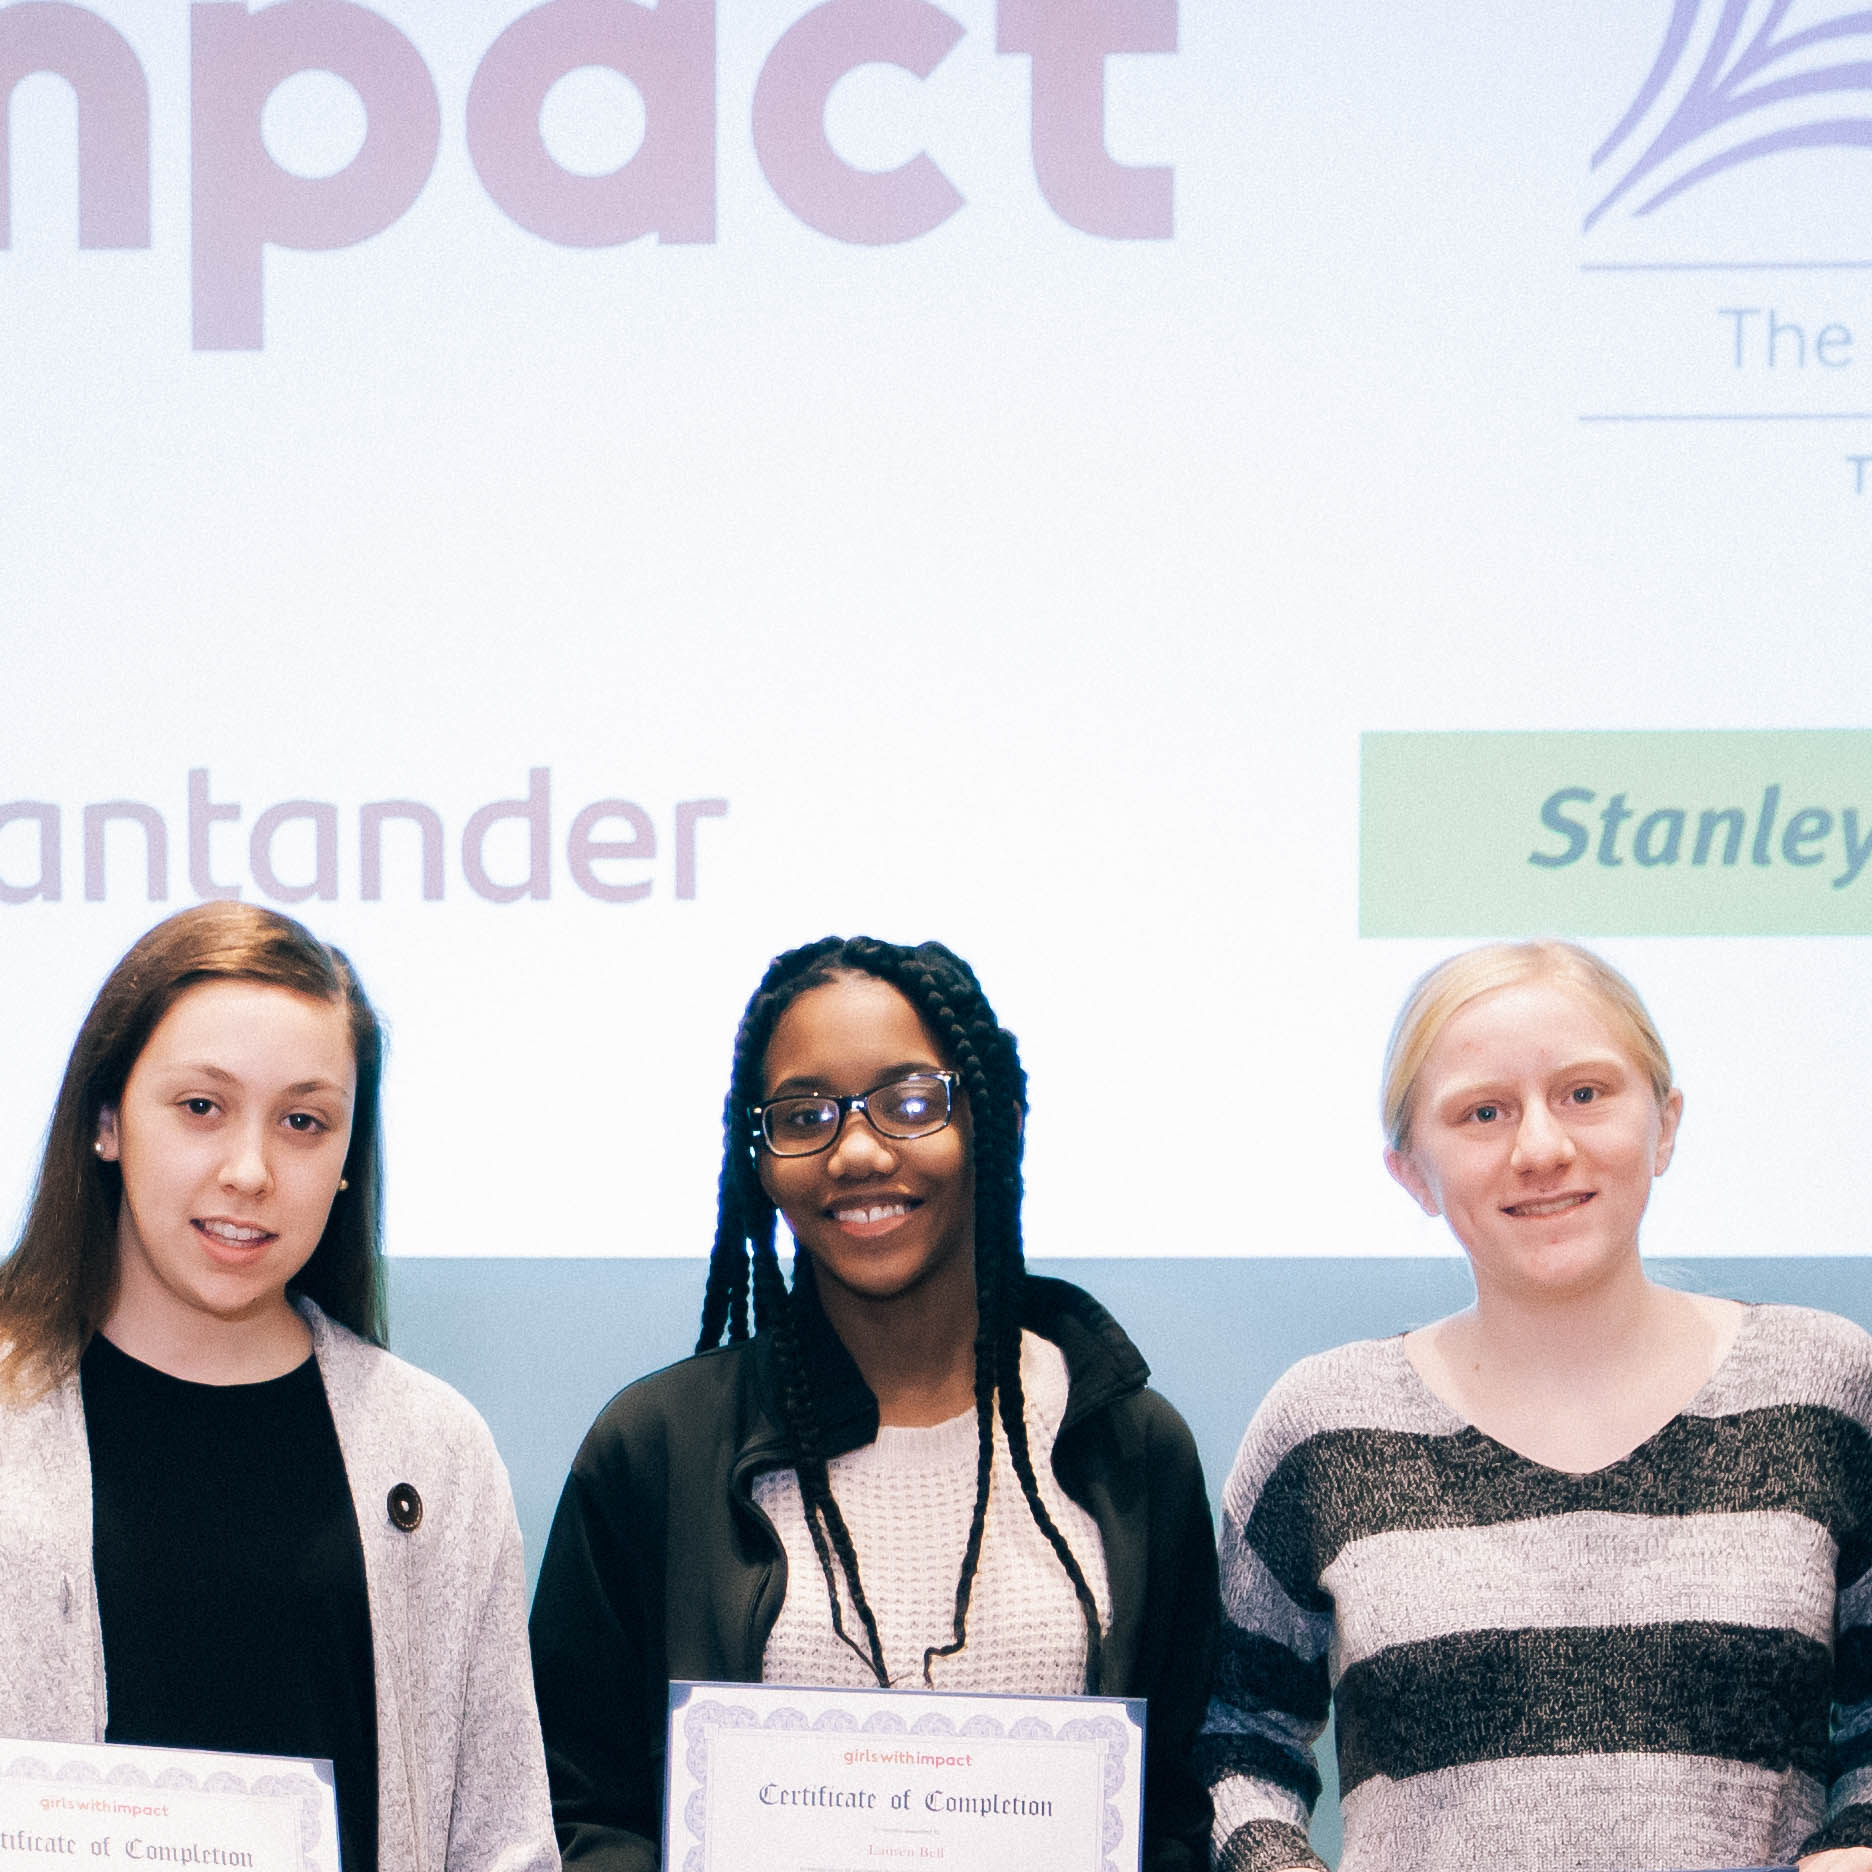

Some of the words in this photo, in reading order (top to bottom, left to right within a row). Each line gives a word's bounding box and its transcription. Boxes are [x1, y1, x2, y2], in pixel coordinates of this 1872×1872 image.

[1717, 305, 1856, 371] The
[759, 1782, 877, 1810] Certificate
[890, 1788, 912, 1811] of
[924, 1789, 1054, 1818] Completion
[90, 1834, 112, 1857] of
[125, 1838, 254, 1868] Completion
